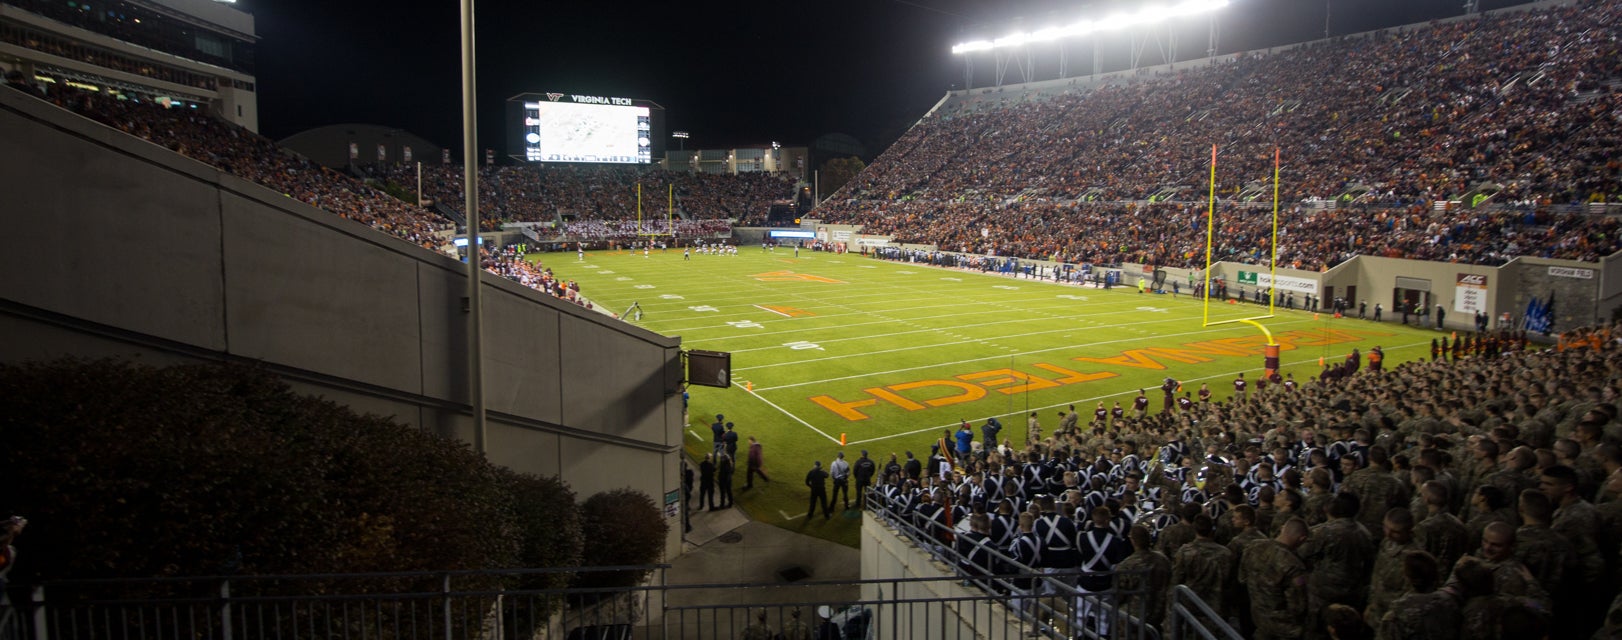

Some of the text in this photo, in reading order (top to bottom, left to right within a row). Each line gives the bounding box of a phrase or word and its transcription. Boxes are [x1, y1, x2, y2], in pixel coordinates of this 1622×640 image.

[571, 94, 632, 106] VIRGINIA TECH
[808, 363, 1121, 422] TECH
